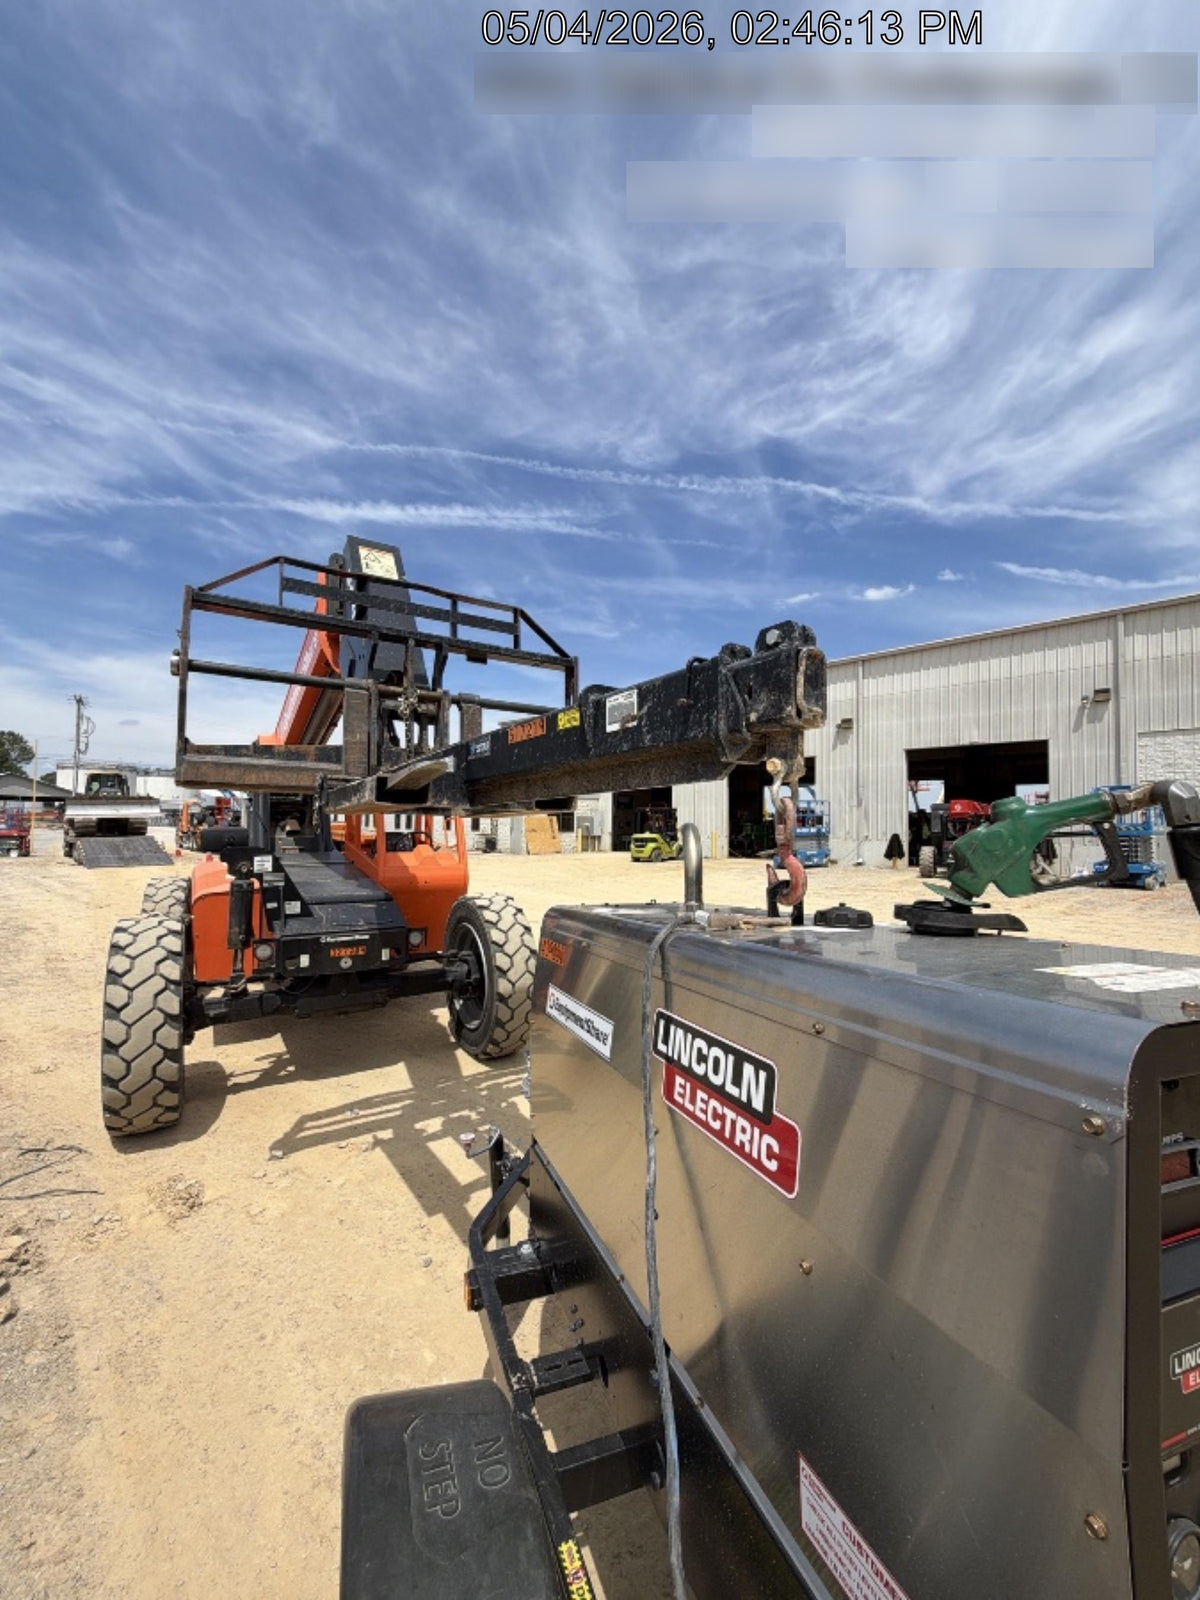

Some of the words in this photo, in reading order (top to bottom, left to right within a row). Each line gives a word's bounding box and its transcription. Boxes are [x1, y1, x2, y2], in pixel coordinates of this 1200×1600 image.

[656, 1017, 767, 1114] LINCOLN
[673, 1074, 780, 1173] ELECTRIC
[419, 1439, 461, 1519] STEP
[473, 1436, 512, 1490] NO
